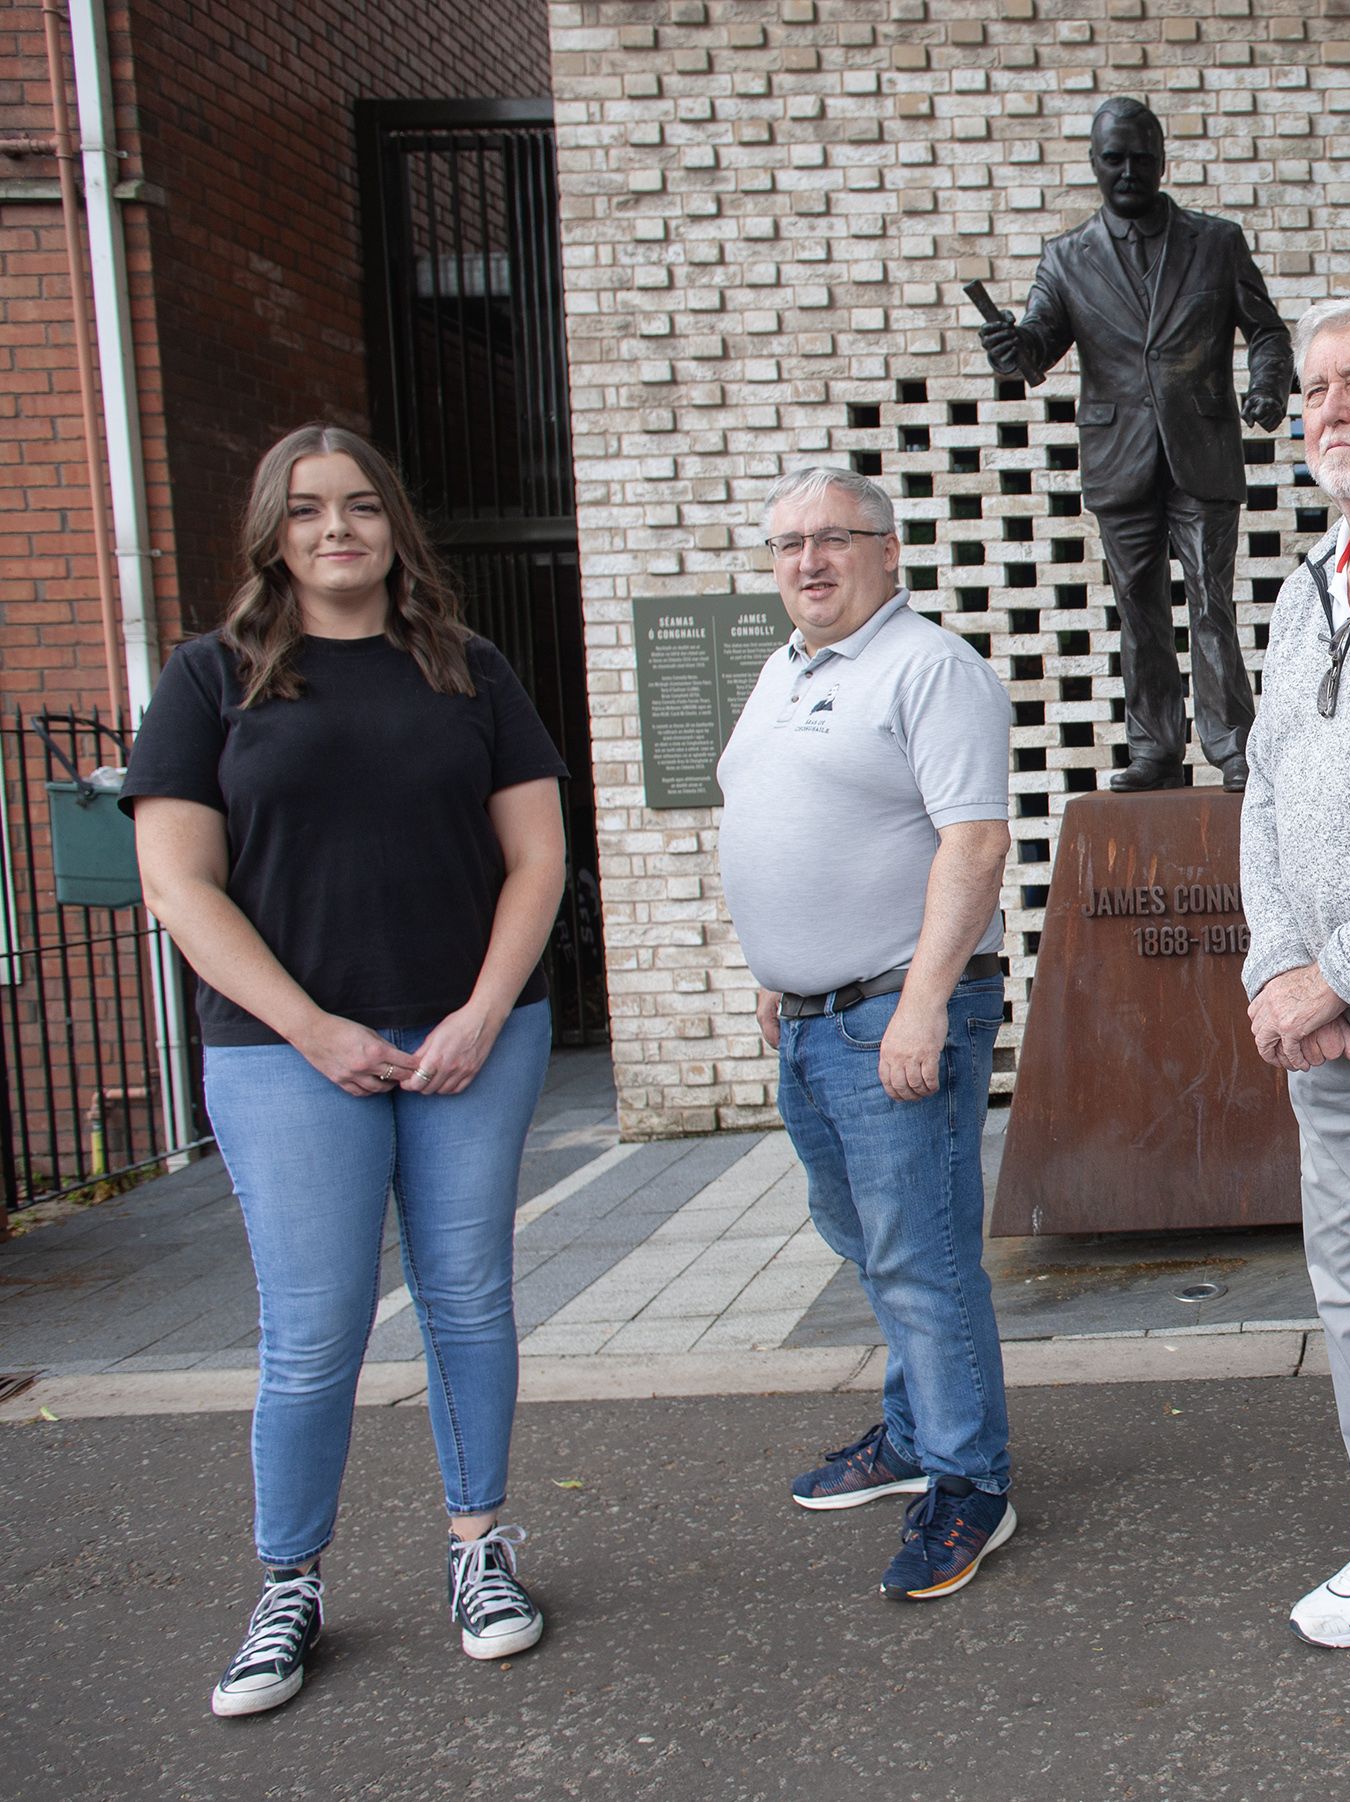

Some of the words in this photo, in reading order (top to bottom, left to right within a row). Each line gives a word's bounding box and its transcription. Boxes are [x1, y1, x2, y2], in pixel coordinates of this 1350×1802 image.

[659, 616, 694, 627] SÉAMAS
[738, 614, 767, 625] JAMES
[657, 628, 706, 639] CONGHAILE
[731, 626, 775, 637] CONNOLLY
[1081, 886, 1166, 917] JAMES
[1133, 924, 1251, 956] 1868-1916
